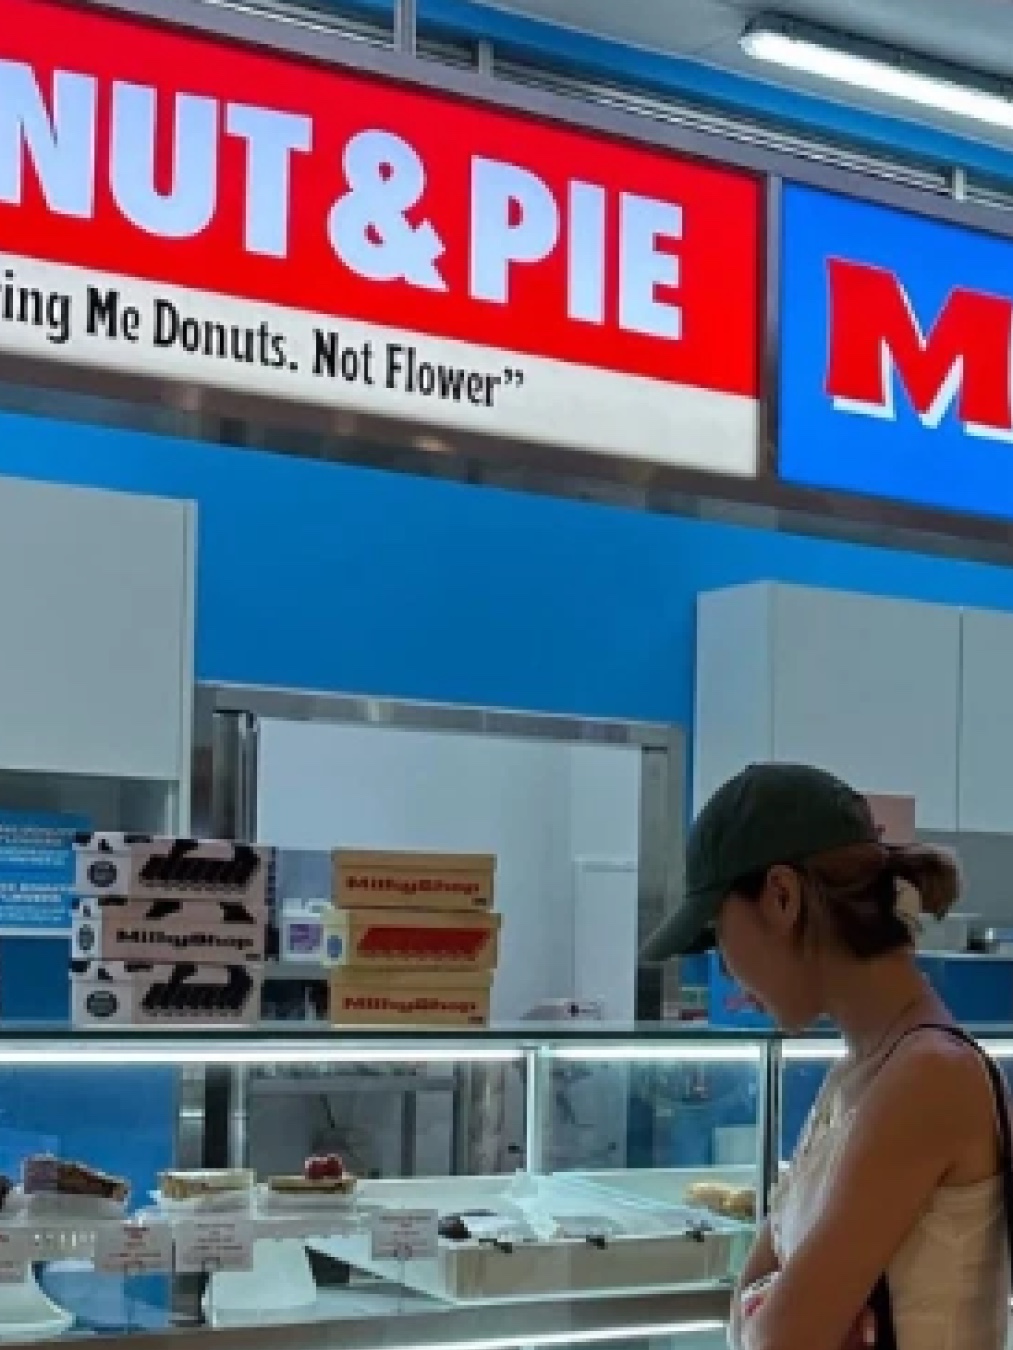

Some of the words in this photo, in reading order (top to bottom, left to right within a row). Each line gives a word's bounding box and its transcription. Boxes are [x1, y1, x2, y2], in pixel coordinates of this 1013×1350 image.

[0, 268, 72, 345] ing
[86, 283, 140, 342] Me
[153, 298, 299, 371] Donuts.
[312, 328, 375, 386] Not
